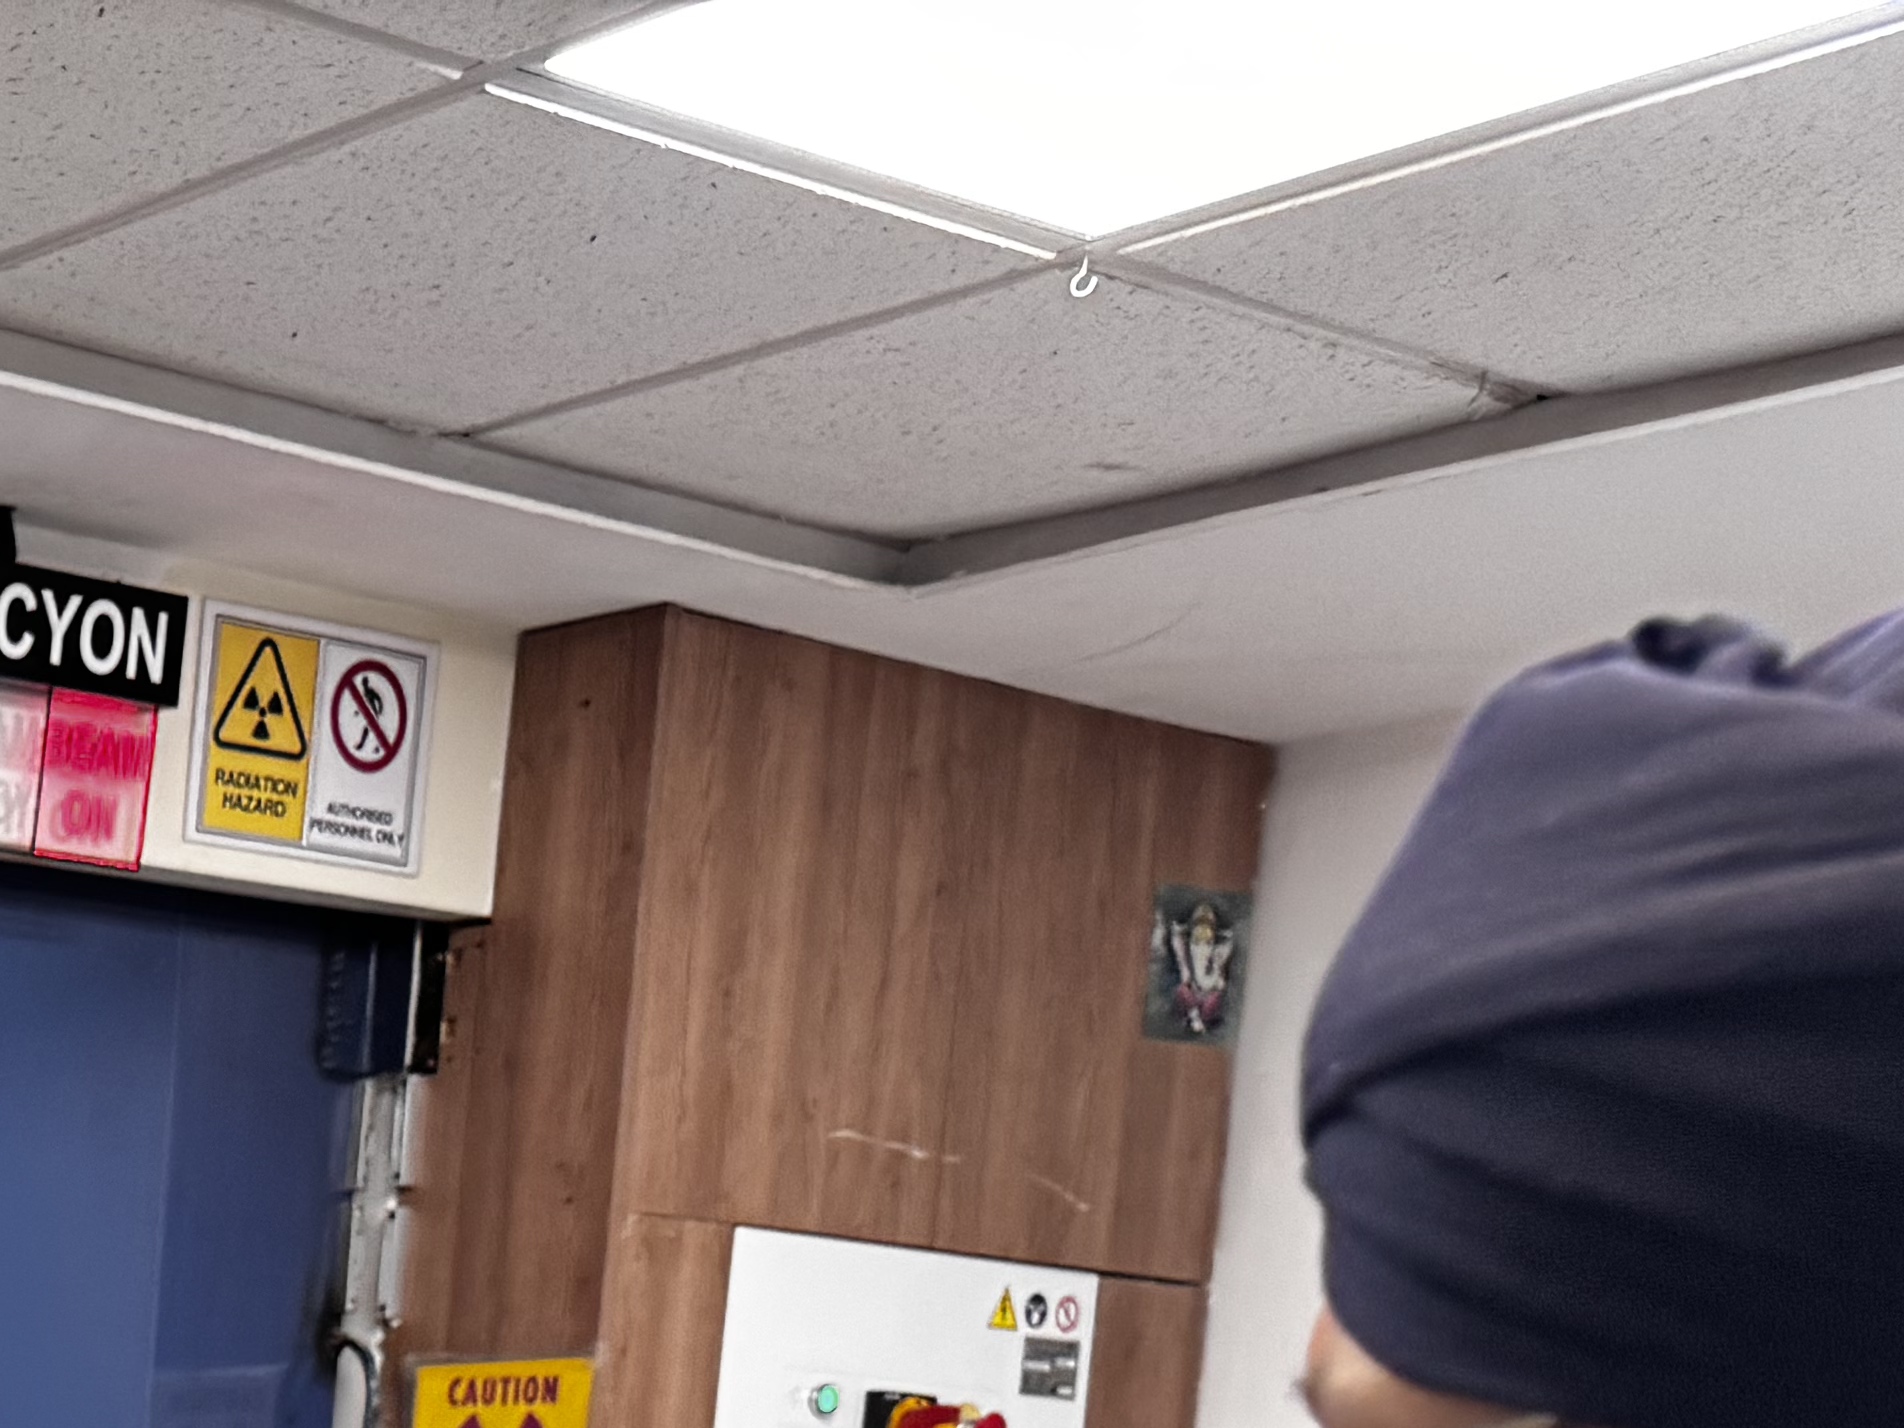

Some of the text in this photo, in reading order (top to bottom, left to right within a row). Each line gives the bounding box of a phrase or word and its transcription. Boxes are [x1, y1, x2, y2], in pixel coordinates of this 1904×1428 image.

[46, 720, 144, 782] BEAM
[215, 768, 298, 799] RADIATION
[56, 789, 120, 840] ON
[222, 792, 287, 818] HAZARD
[310, 817, 372, 842] PERSONNEL
[447, 1375, 560, 1406] CAUTION
